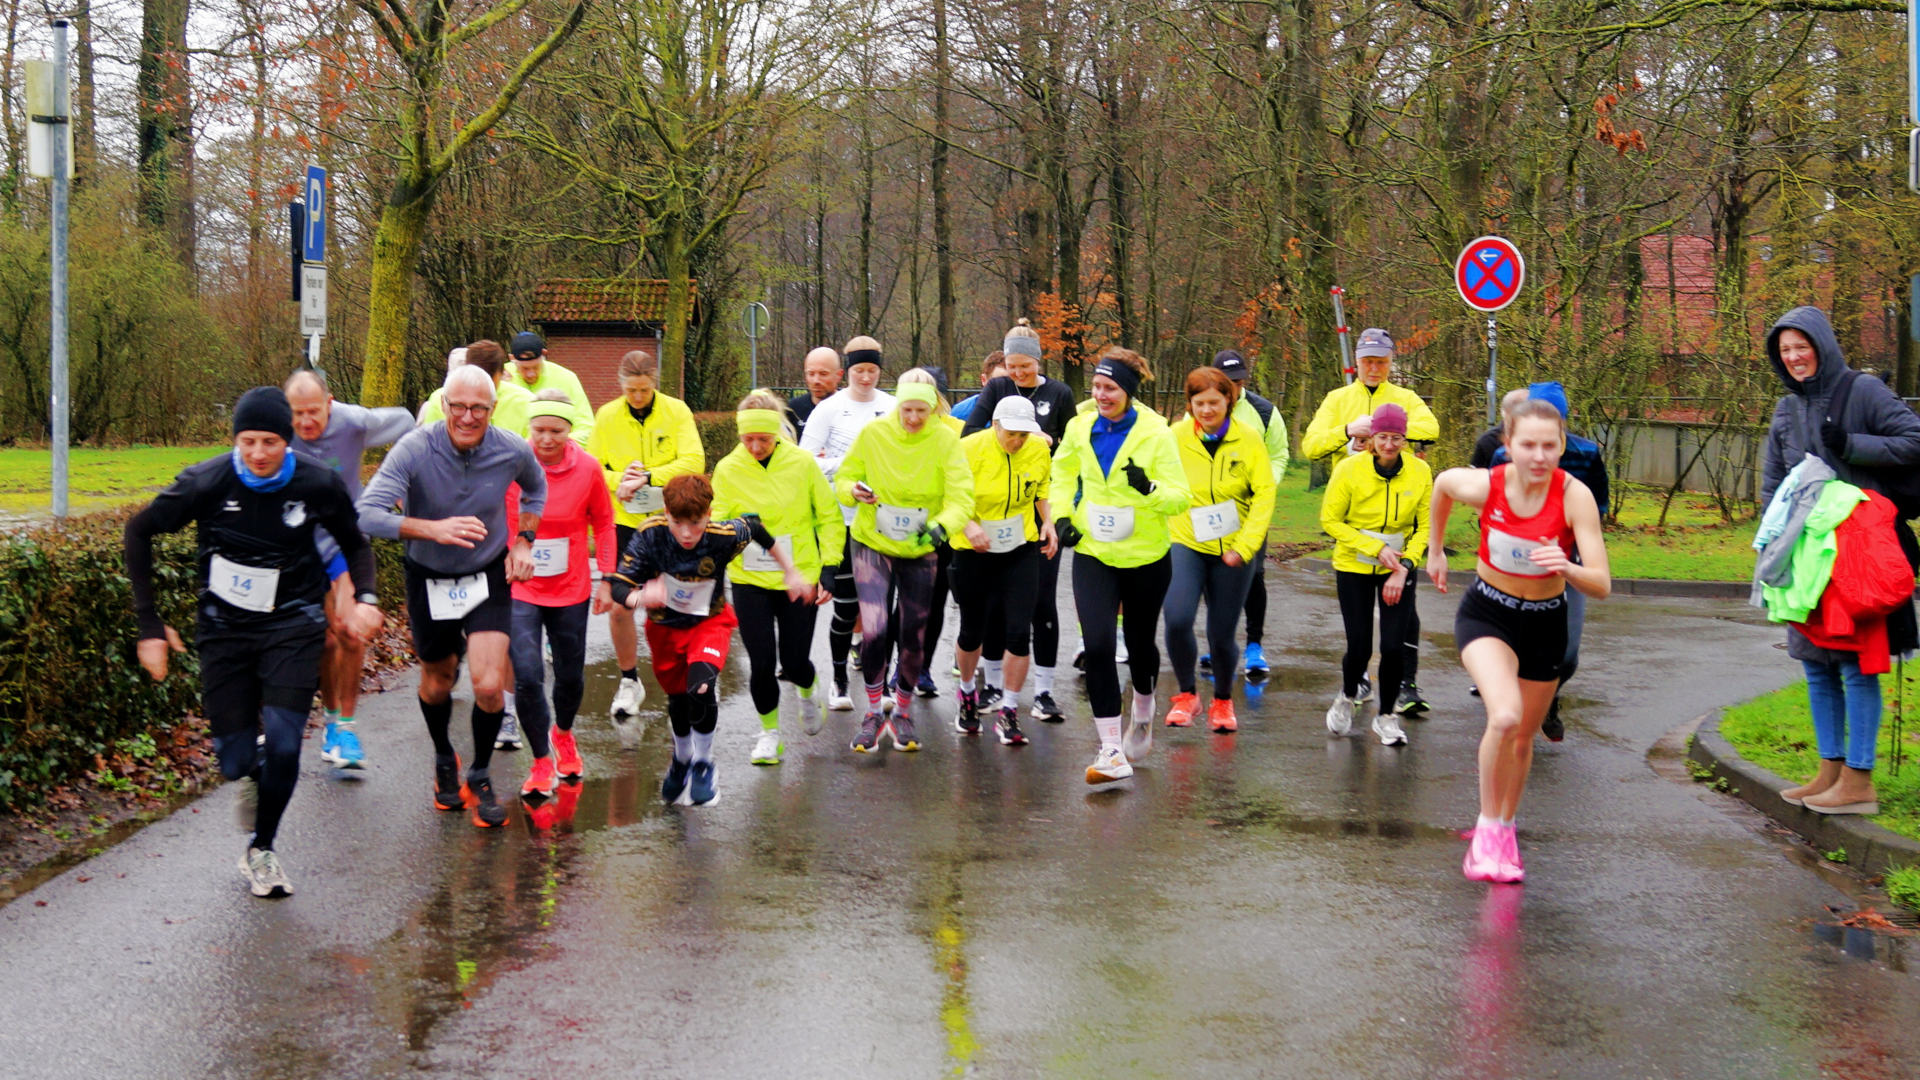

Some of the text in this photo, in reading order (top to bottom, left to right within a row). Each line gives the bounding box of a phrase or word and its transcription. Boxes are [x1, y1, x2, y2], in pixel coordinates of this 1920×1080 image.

[309, 178, 321, 249] P
[895, 515, 910, 527] 19
[1098, 514, 1116, 527] 23
[1208, 513, 1222, 526] 21
[997, 527, 1013, 539] 22
[533, 549, 551, 561] 45
[231, 575, 253, 591] 14
[448, 586, 468, 601] 66
[1477, 581, 1561, 612] NIKE PRO
